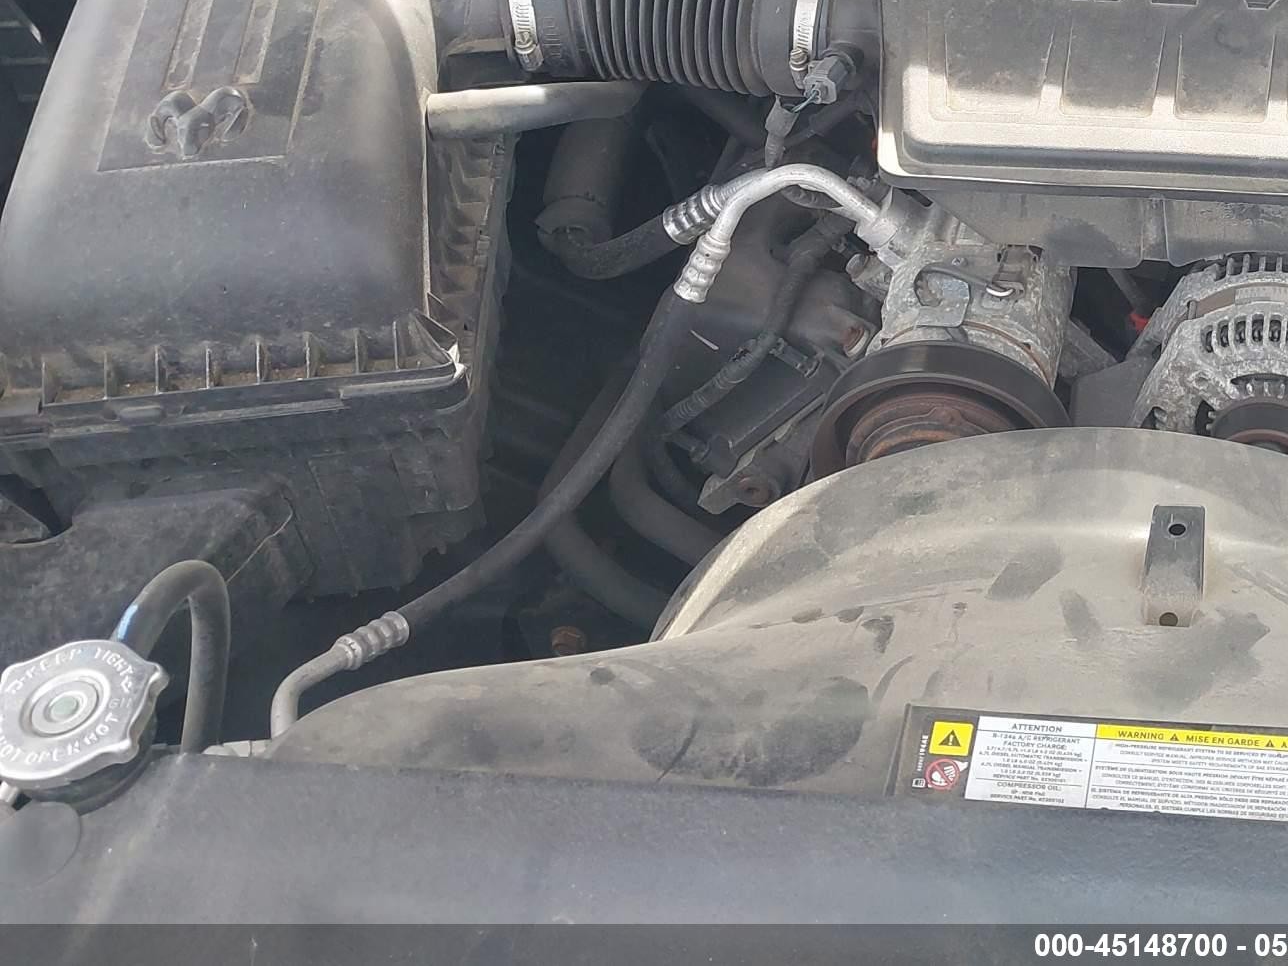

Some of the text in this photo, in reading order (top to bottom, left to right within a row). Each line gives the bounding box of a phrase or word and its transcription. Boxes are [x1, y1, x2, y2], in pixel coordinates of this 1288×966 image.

[84, 712, 119, 745] HOT
[1011, 723, 1062, 733] ATTENTION
[1032, 735, 1080, 744] REFRIGERANT
[1117, 730, 1164, 740] WARNING
[1227, 737, 1259, 746] GARDE
[996, 781, 1045, 789] COMPRESSOR
